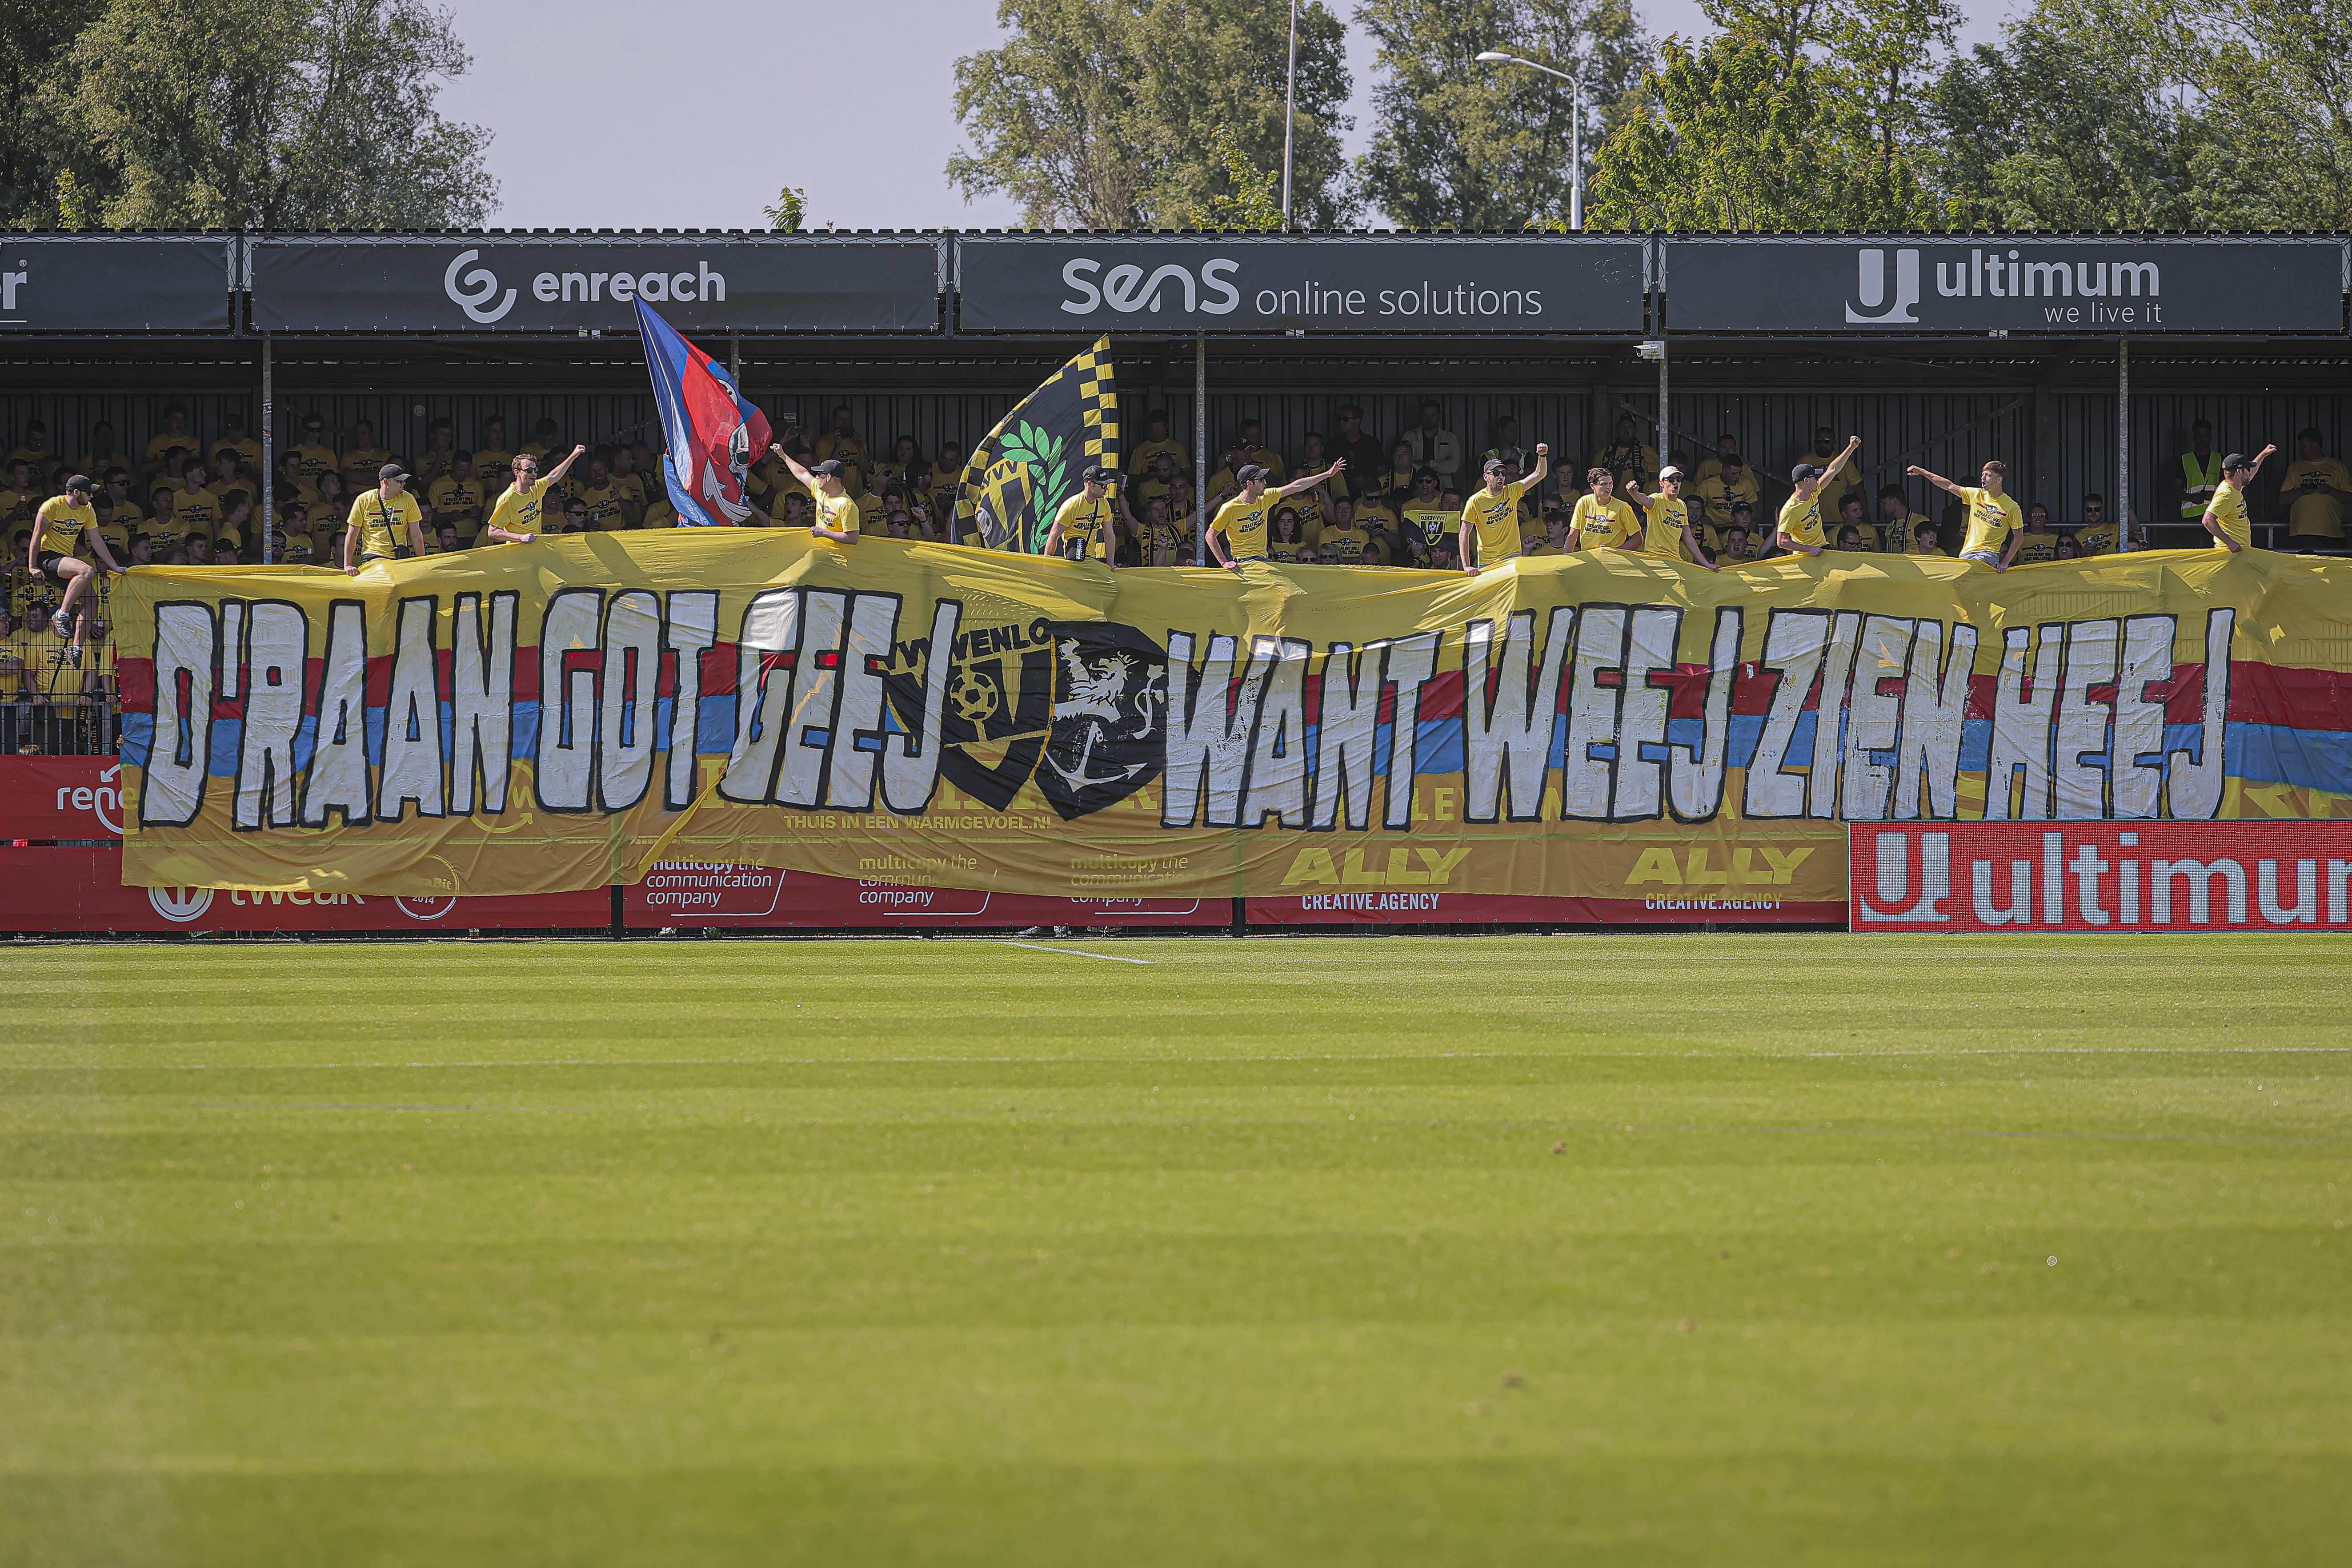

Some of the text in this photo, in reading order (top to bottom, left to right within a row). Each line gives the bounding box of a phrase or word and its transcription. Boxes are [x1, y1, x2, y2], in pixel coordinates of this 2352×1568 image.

[533, 261, 725, 302] enreach
[1937, 249, 2160, 297] ultimum
[1255, 281, 1366, 315] online
[1378, 281, 1543, 315] solutions
[2044, 302, 2162, 323] we live it
[138, 584, 2236, 832] D'RAAN GOT GEEJ WANT WEEJ ZIEN HEEJ
[784, 815, 1052, 830] THUIS IN EEN WARMGEVOEL.NL
[951, 854, 977, 869] the
[1162, 854, 1188, 869] the
[1280, 847, 1472, 885] ALLY
[1624, 847, 1816, 885] ALLY
[646, 872, 772, 888] communication
[1971, 832, 2352, 925] ultimu
[646, 892, 721, 908] company
[859, 890, 934, 907] company
[1302, 893, 1439, 910] CREATIVE.AGENCY
[1646, 893, 1781, 910] CREATIVE.AGENCY
